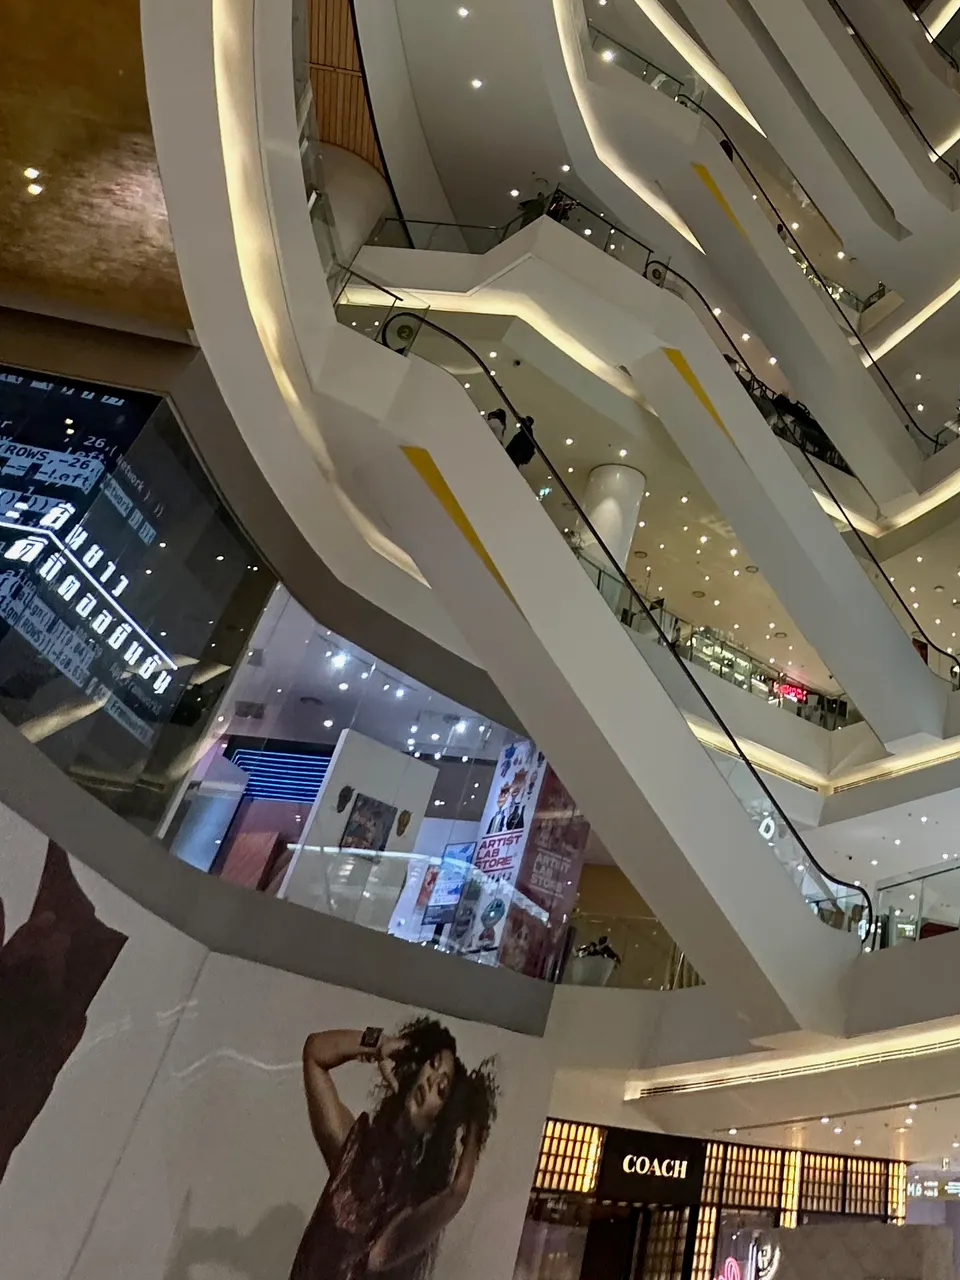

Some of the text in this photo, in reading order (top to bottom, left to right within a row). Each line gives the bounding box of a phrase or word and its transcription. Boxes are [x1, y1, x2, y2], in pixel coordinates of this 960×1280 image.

[480, 835, 523, 850] ARTIST
[476, 848, 500, 861] LAB
[474, 856, 512, 870] STORE
[622, 1153, 688, 1179] COACH
